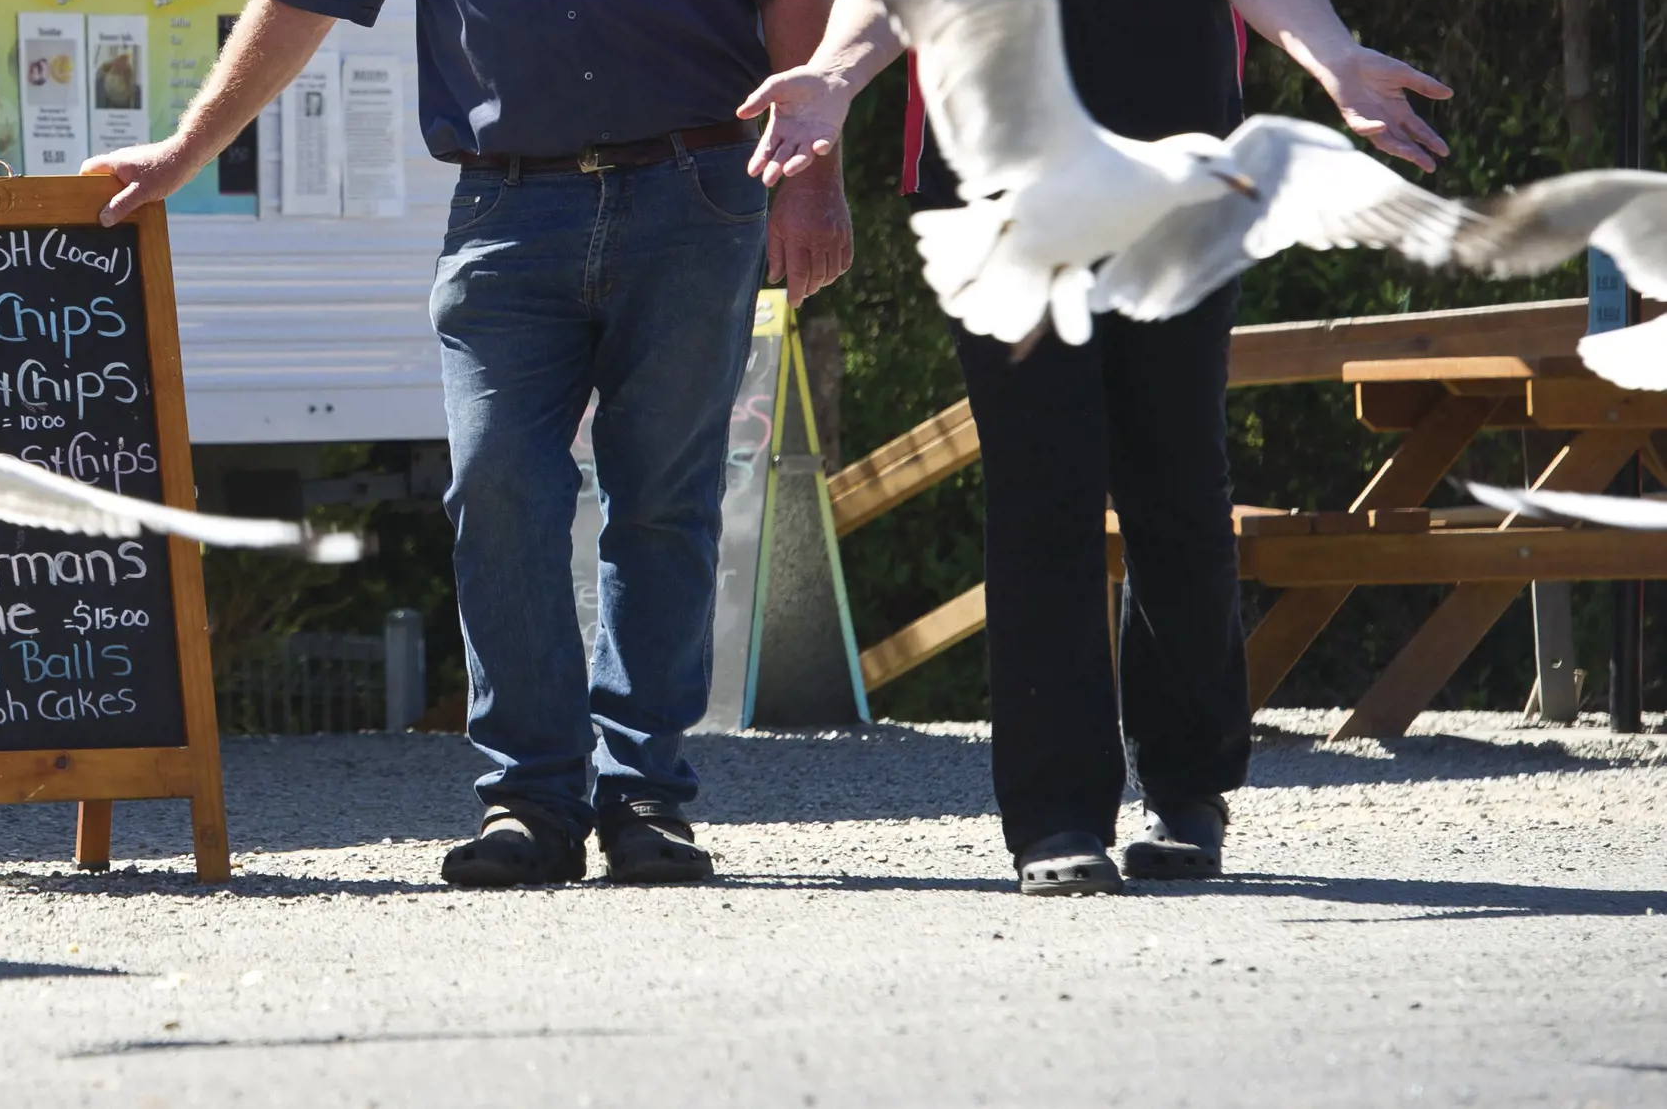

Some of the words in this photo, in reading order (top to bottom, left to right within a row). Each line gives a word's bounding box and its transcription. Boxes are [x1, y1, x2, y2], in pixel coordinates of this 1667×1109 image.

[39, 228, 133, 286] (Local)
[17, 358, 138, 420] Chips
[68, 431, 158, 496] Chips
[10, 639, 133, 684] Balls
[37, 687, 137, 722] Cakes
